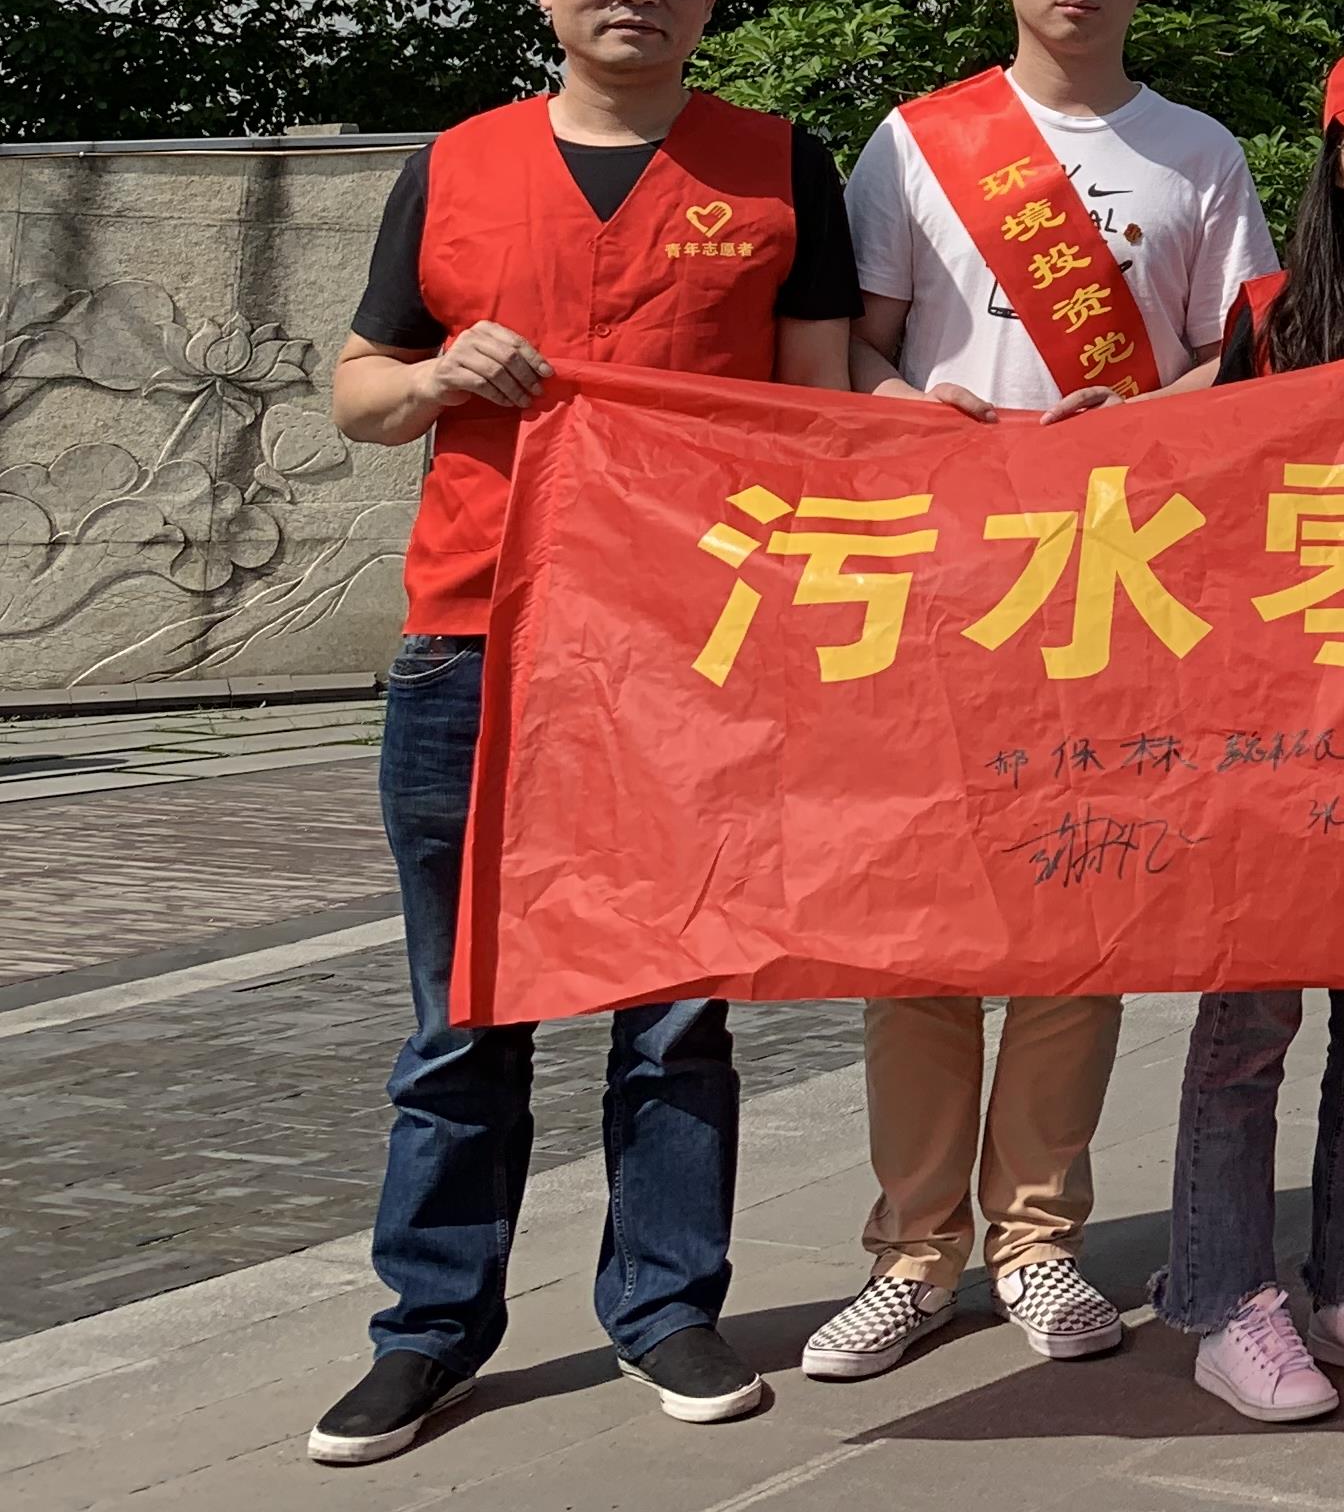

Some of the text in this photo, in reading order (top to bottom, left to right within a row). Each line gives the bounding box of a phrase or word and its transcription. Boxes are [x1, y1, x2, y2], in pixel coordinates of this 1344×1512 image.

[664, 240, 755, 259] 青年志愿者
